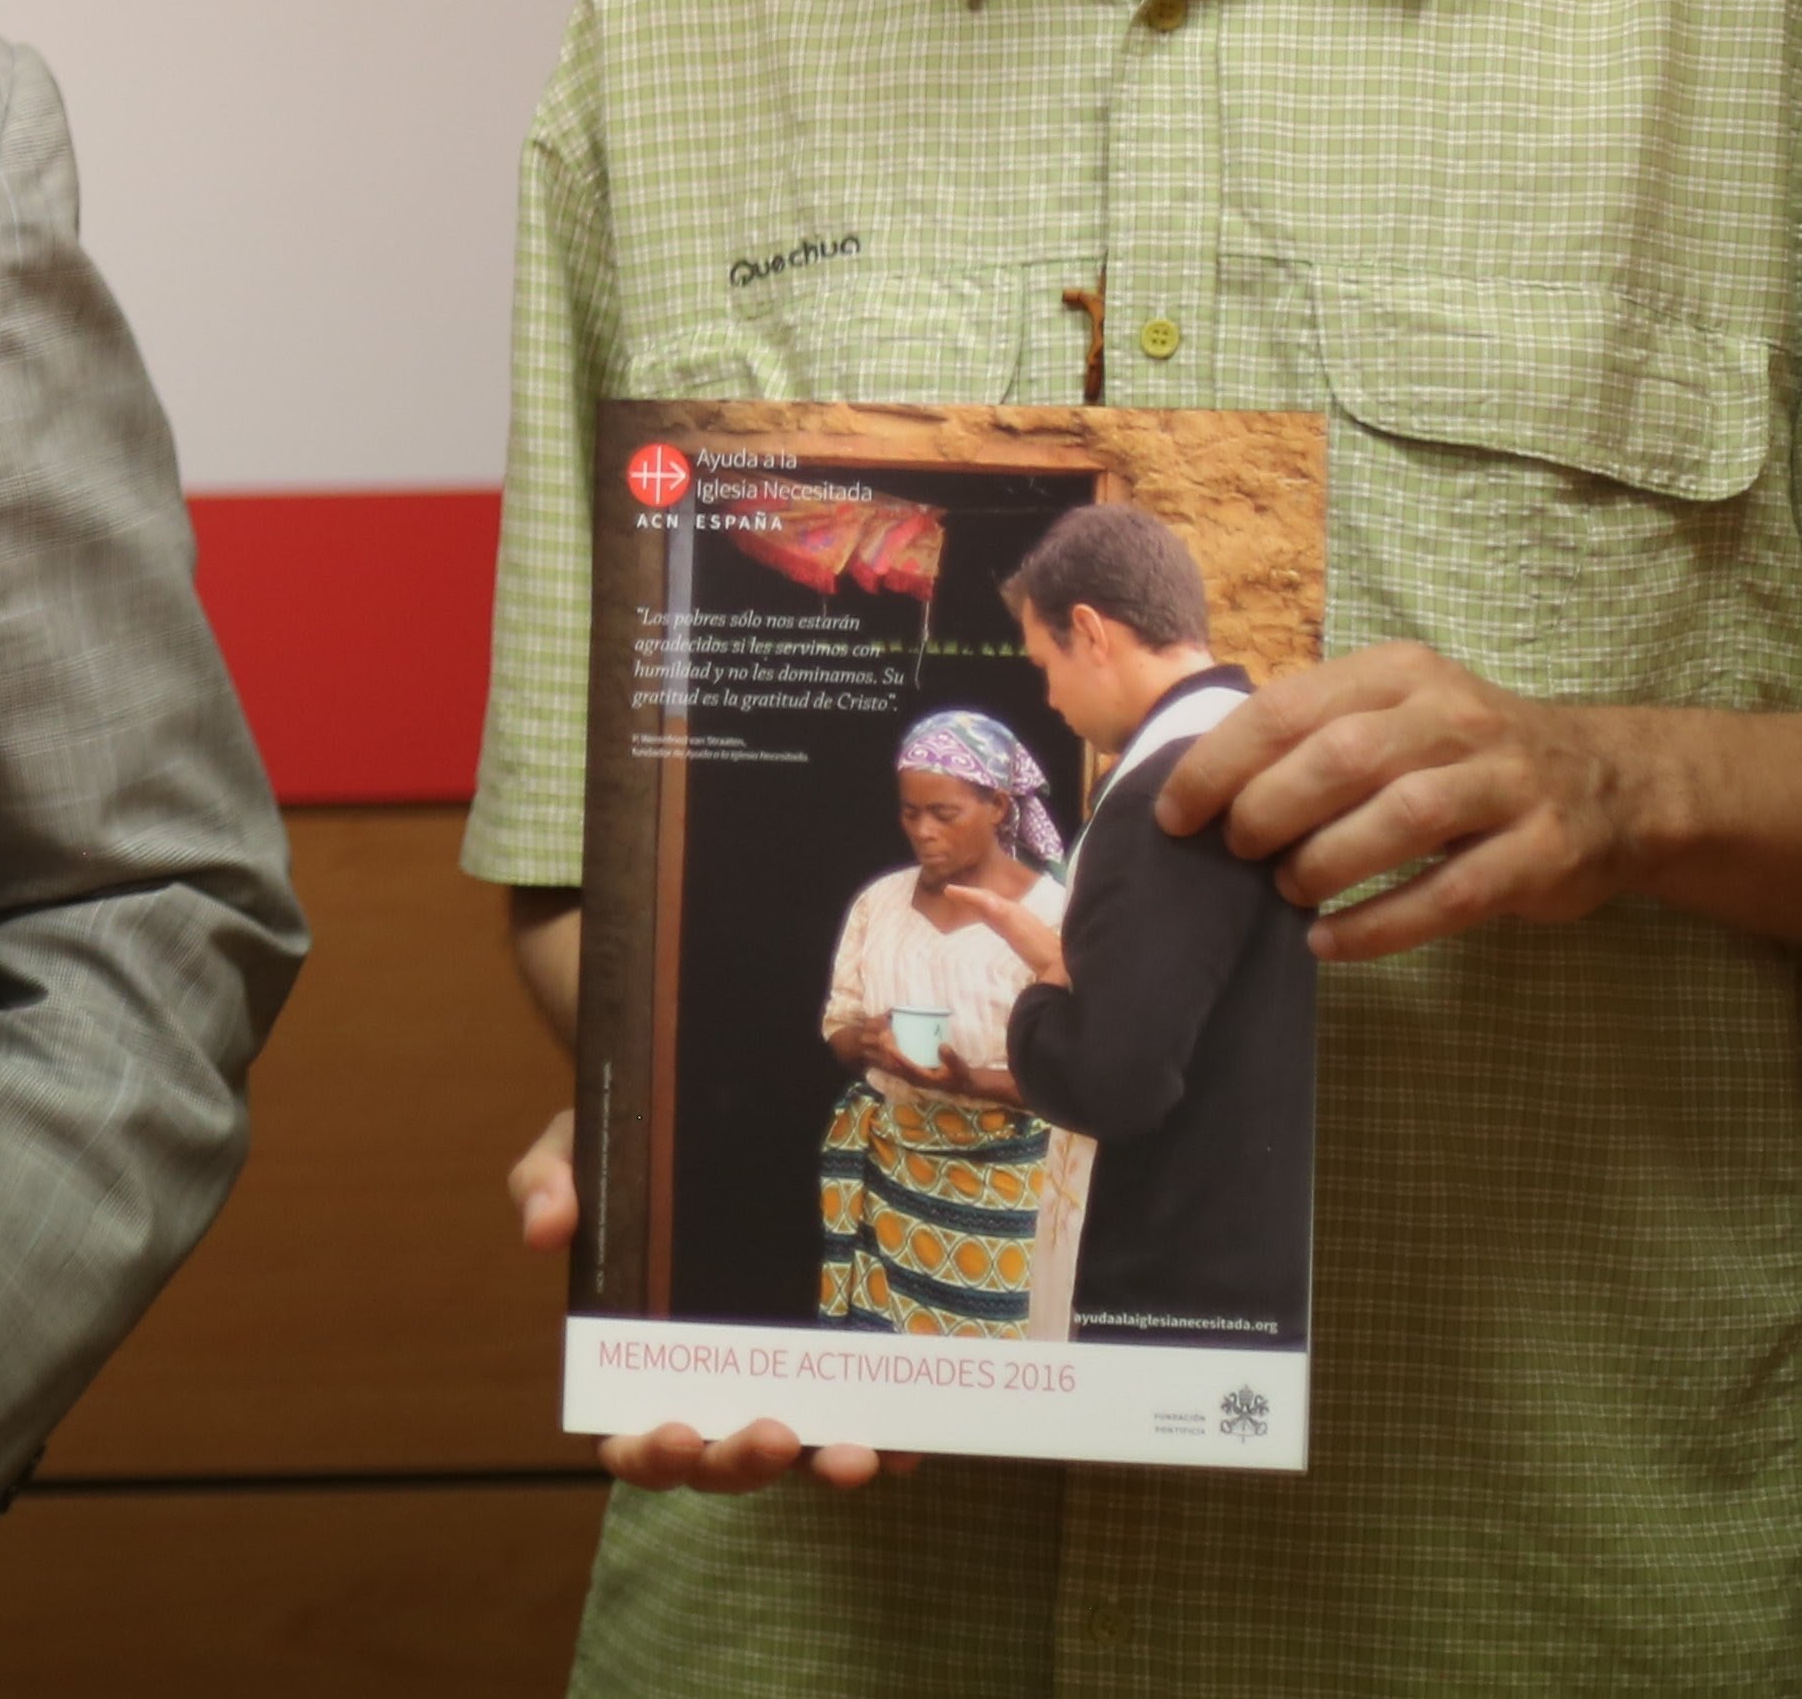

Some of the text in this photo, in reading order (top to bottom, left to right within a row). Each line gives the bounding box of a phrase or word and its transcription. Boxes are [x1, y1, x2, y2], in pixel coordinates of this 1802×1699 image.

[696, 447, 798, 474] Ayuda a la
[696, 479, 873, 504] Iglesia Necesitada
[636, 510, 783, 531] ACN ESPAÑA
[672, 608, 726, 630] pobres
[730, 608, 762, 629] sólo
[766, 615, 794, 630] nos
[797, 613, 861, 632] estarán
[634, 635, 881, 659] agradecidos si les servimos con
[633, 659, 905, 686] humildad y no les dominamos. Su
[631, 688, 699, 710] gratitud
[702, 692, 719, 706] es
[723, 688, 738, 707] la
[740, 690, 811, 713] gratitud
[813, 692, 833, 710] de
[1073, 1311, 1279, 1335] ayudaalaiglesianecesitada.org
[597, 1339, 1077, 1394] MEMORIA DE ACTIVIDADES 2016
